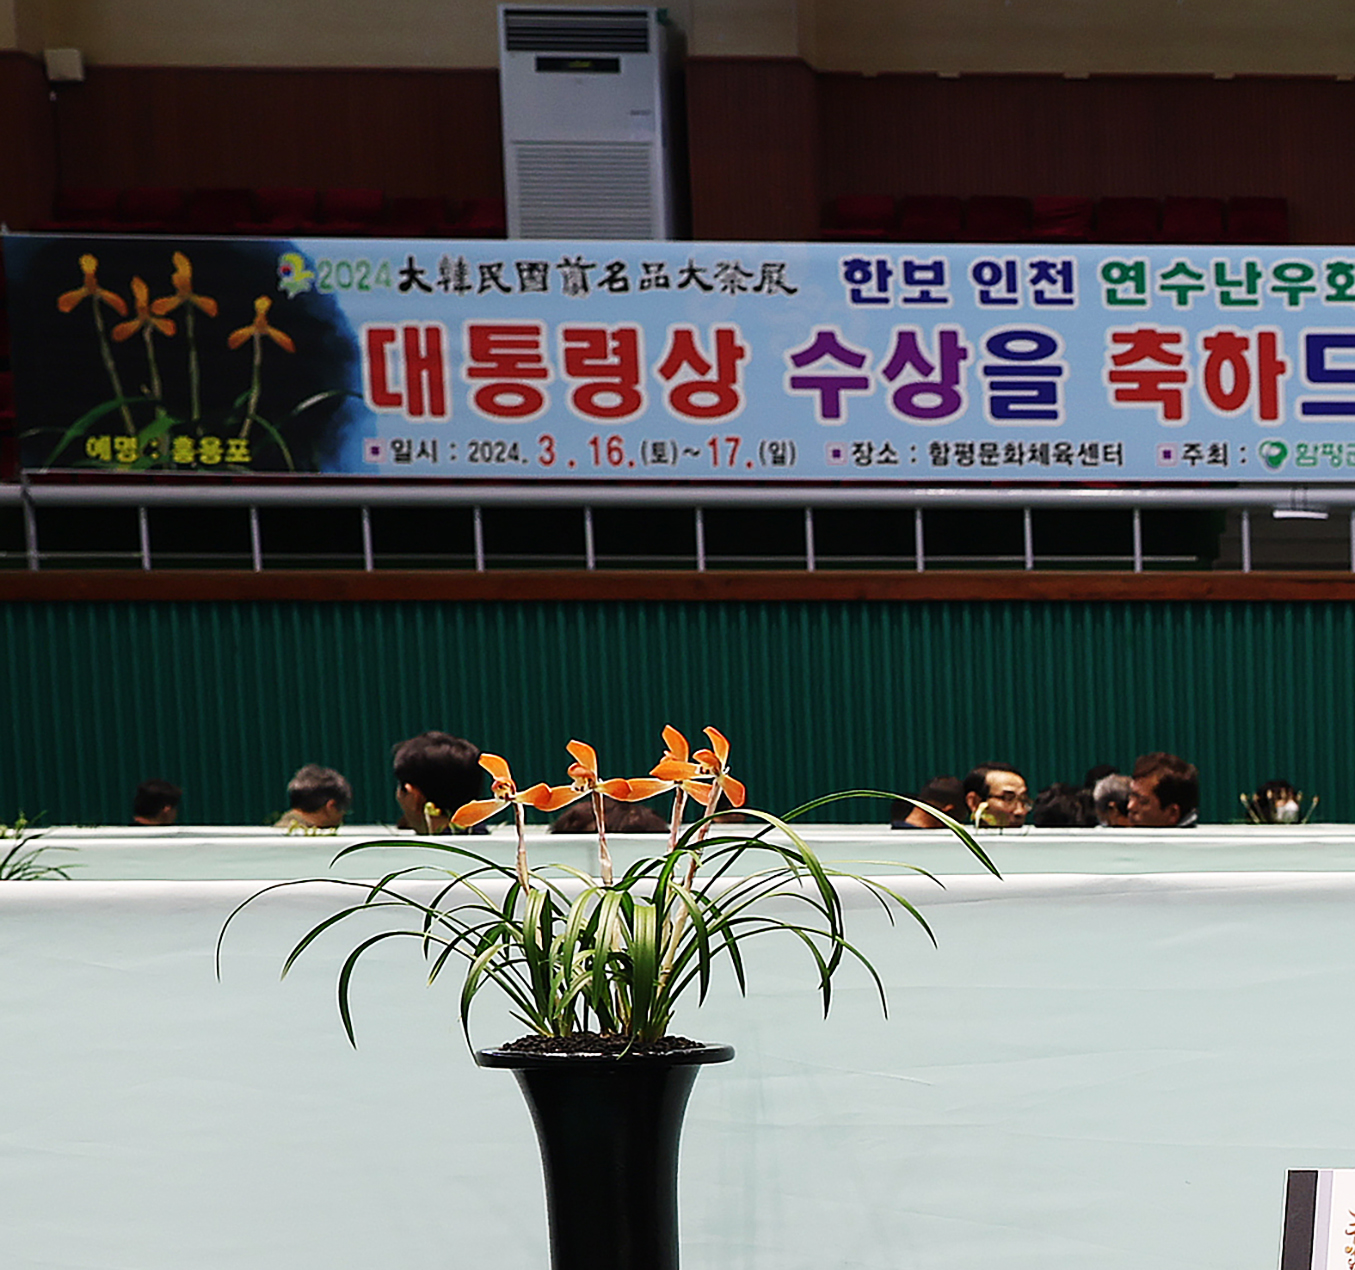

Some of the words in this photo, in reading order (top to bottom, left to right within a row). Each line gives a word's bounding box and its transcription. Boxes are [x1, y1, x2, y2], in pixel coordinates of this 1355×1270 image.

[842, 258, 951, 305] 한보
[971, 259, 1077, 305] 인천
[365, 324, 744, 420] 대통령상
[789, 328, 1063, 421] 수상을
[391, 438, 438, 464] 일시
[851, 441, 899, 467] 장소
[928, 442, 1124, 467] 함평문화체육센터
[1182, 442, 1229, 467] 주최
